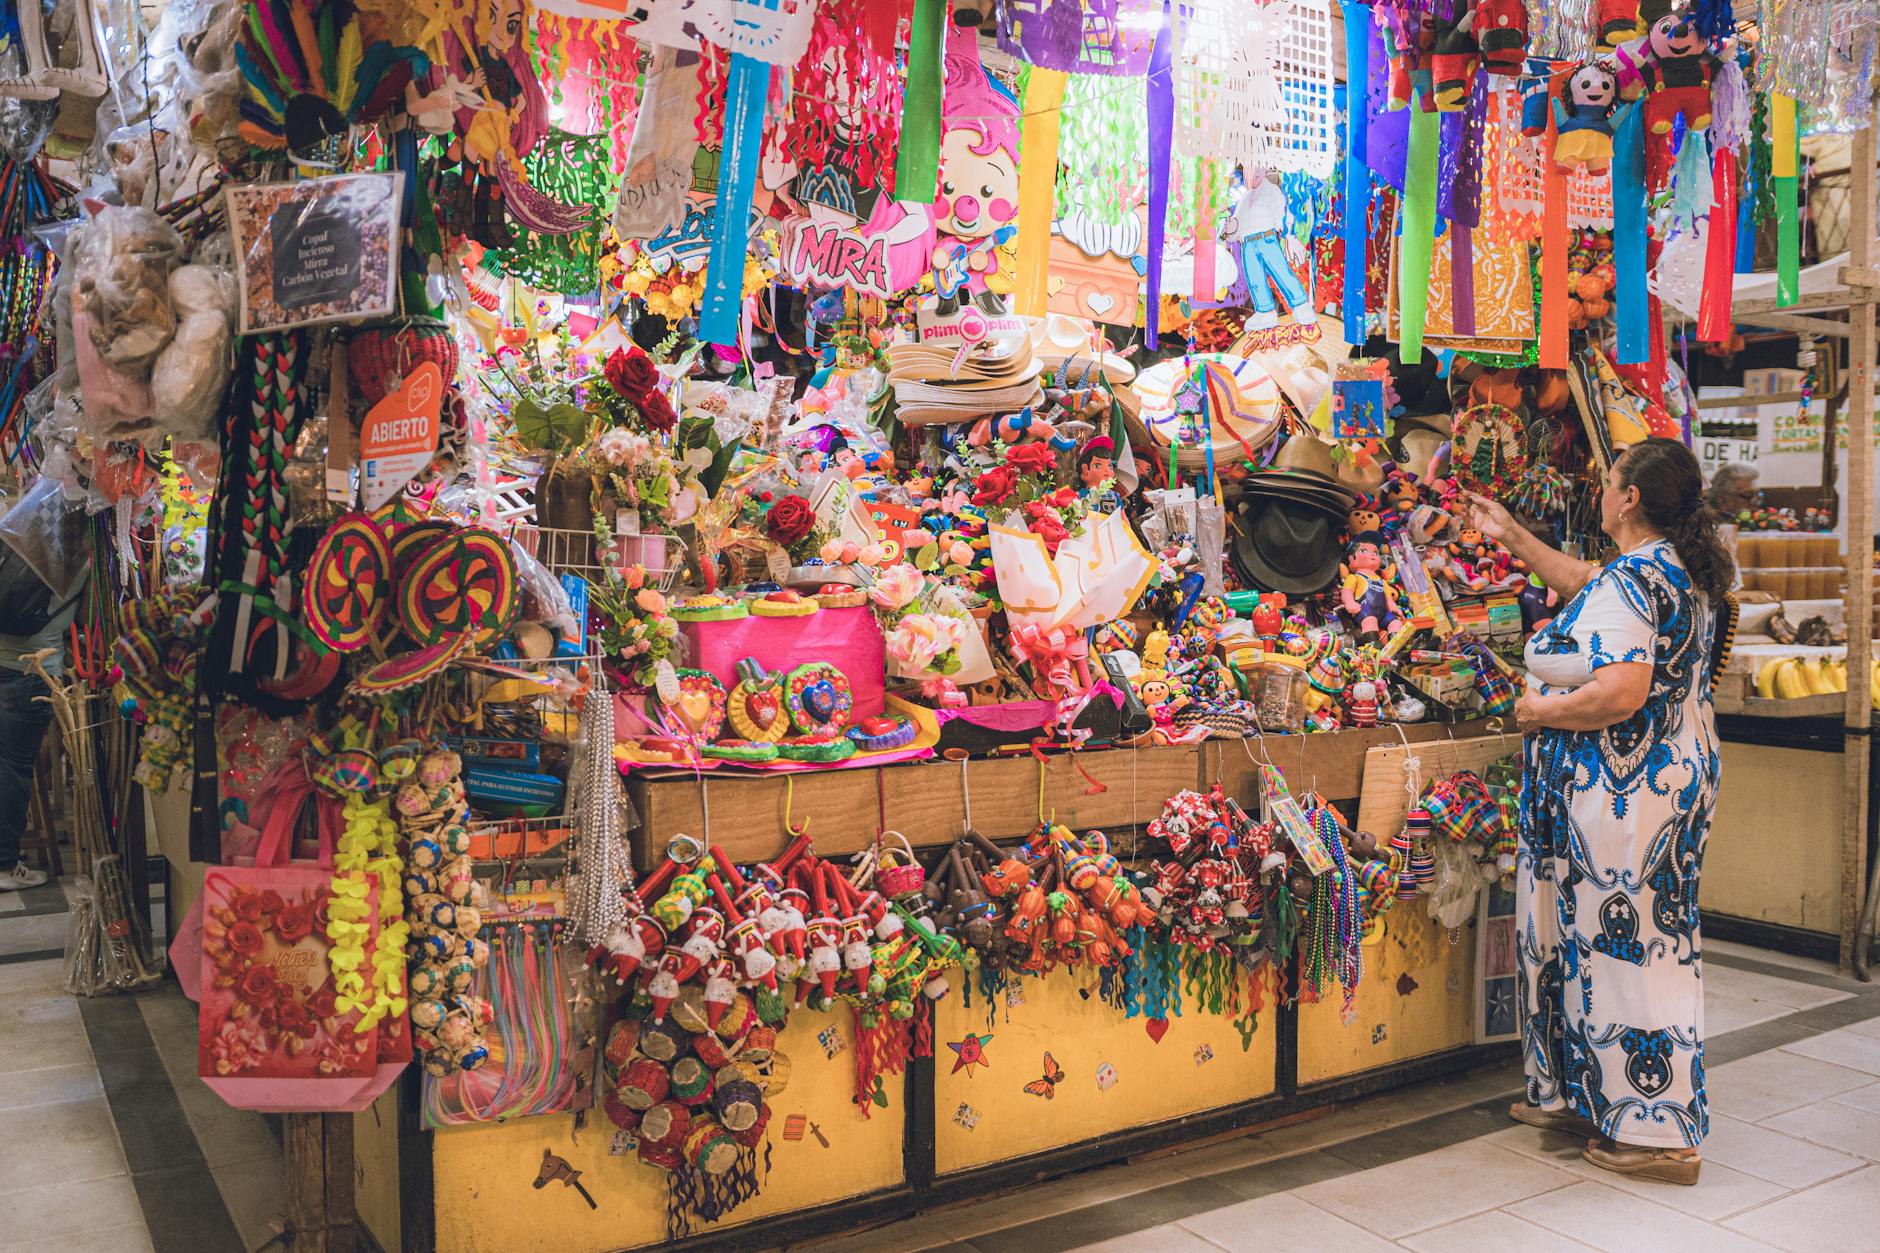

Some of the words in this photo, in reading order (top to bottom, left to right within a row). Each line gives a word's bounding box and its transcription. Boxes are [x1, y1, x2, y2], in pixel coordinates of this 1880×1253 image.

[302, 230, 328, 245] Copal
[298, 244, 335, 260] Incienso
[795, 224, 887, 291] MIRA
[304, 257, 328, 269] Mirra
[314, 263, 349, 280] Vegetal
[923, 323, 959, 340] plim
[988, 318, 1021, 332] plim
[370, 415, 429, 444] ABIERTO
[1775, 428, 1819, 439] TORTAS
[1703, 442, 1730, 461] DE
